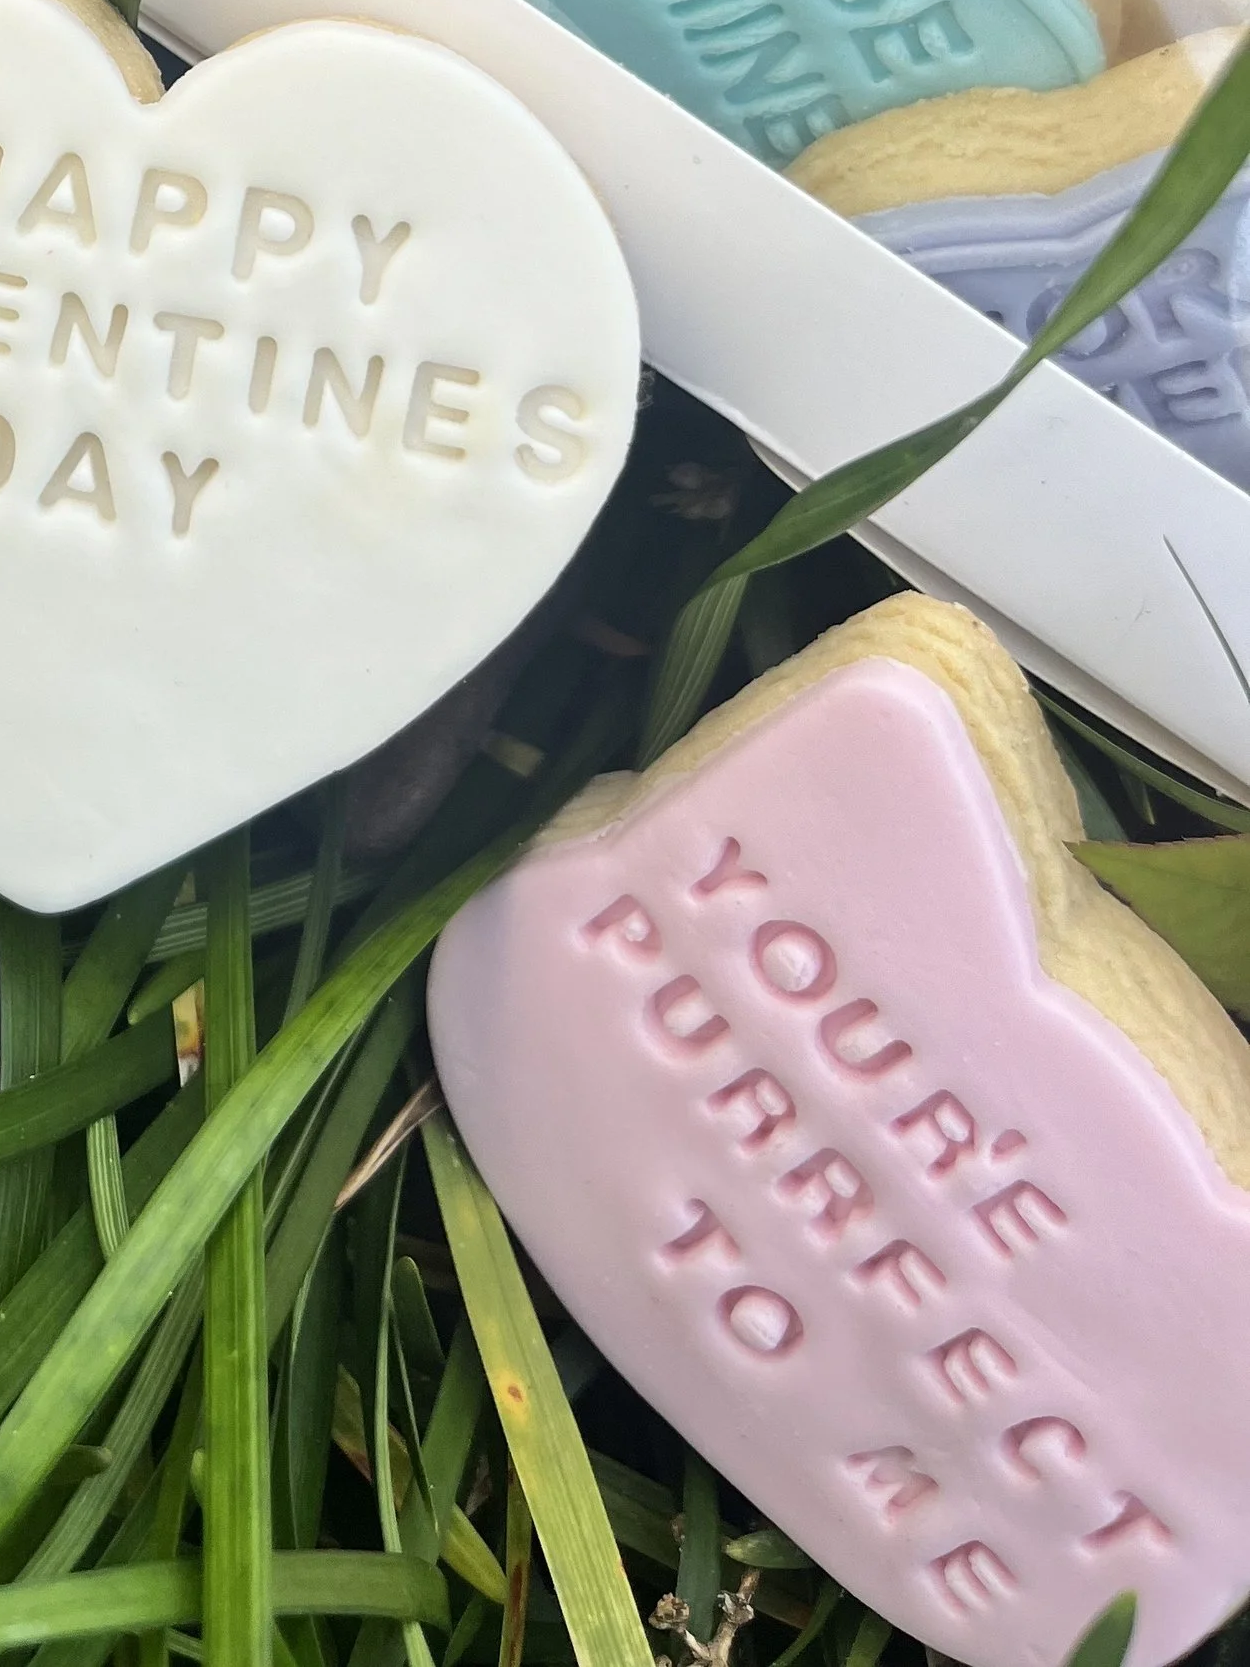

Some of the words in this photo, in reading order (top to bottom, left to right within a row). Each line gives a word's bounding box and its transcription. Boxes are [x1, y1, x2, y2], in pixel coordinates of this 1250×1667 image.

[578, 894, 1174, 1558] PURRFECT
[657, 1198, 805, 1360] TO
[846, 1445, 1018, 1616] ME
